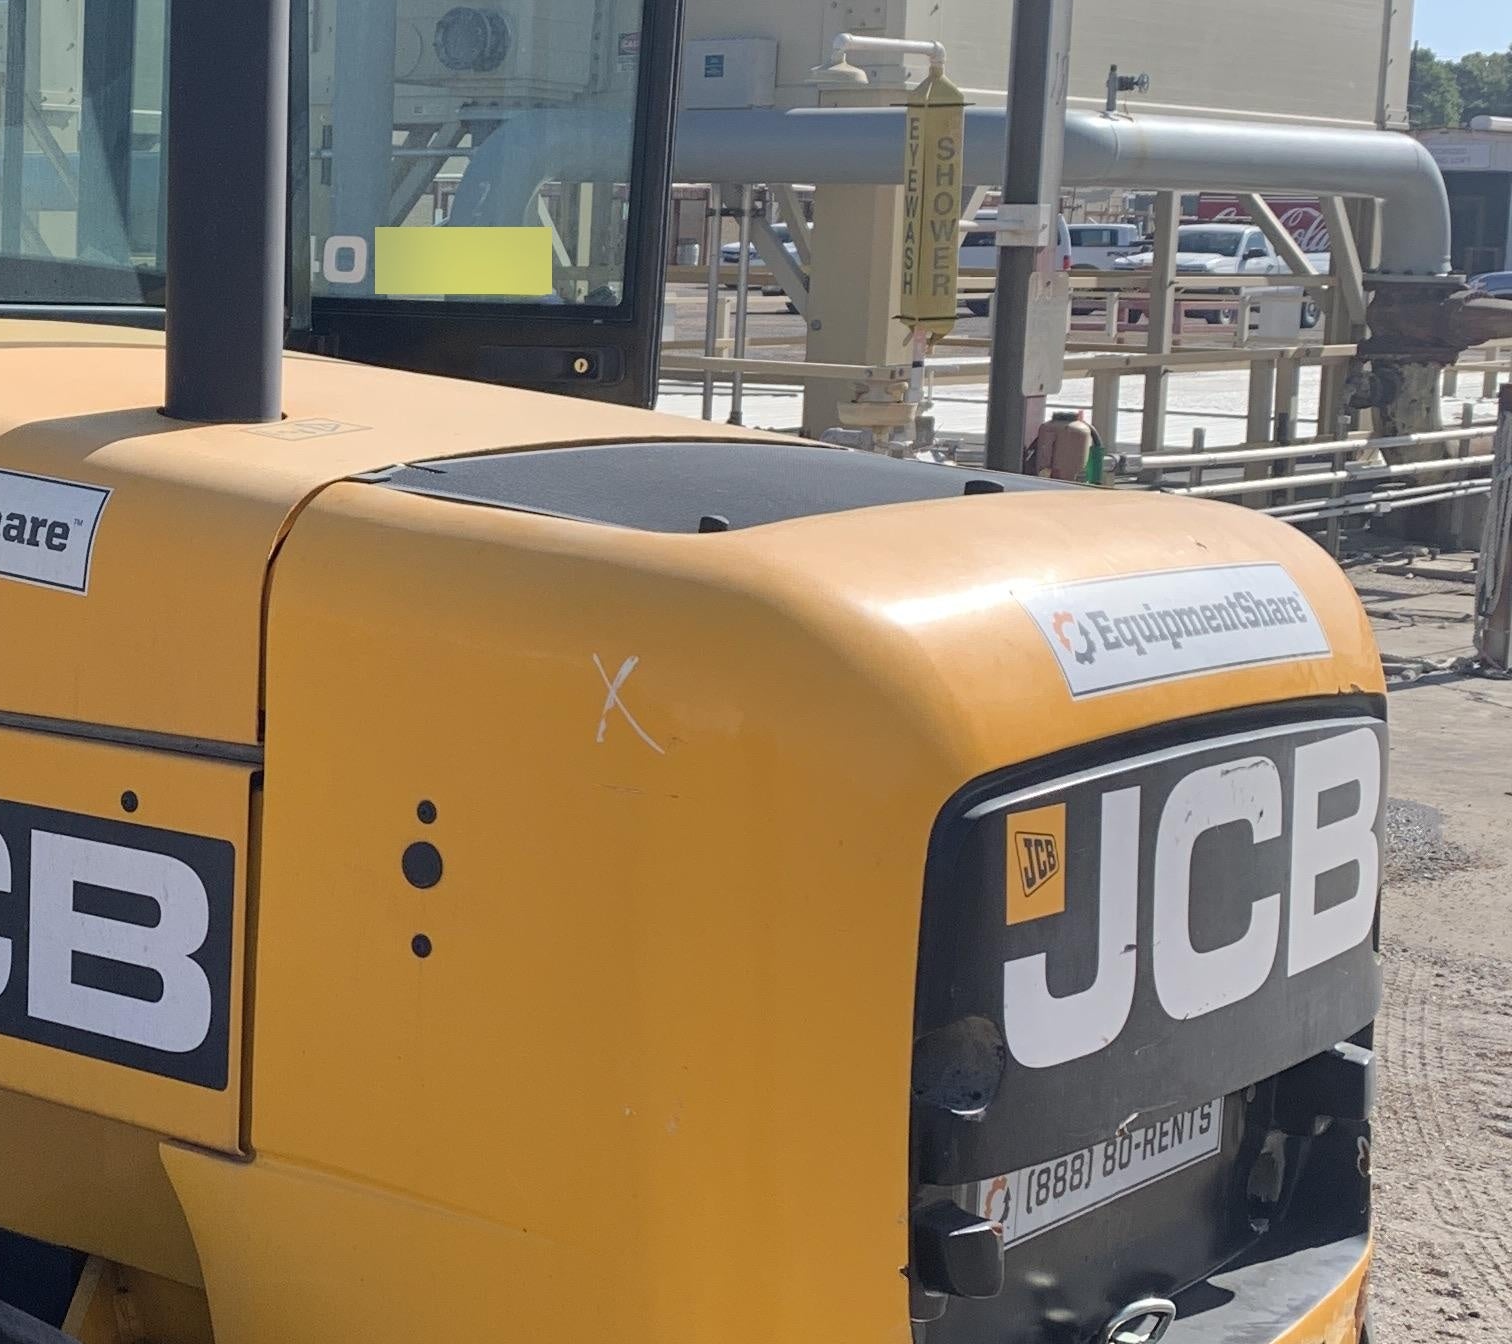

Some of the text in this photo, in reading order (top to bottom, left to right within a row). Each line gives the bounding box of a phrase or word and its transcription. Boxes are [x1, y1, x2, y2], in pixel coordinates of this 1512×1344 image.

[901, 117, 921, 295] EYEWASH
[929, 136, 957, 297] SHOWER
[1086, 591, 1308, 657] EquipmentShare
[1003, 727, 1382, 1069] JCB
[1021, 833, 1057, 892] JCB
[1025, 1147, 1094, 1215] (888)
